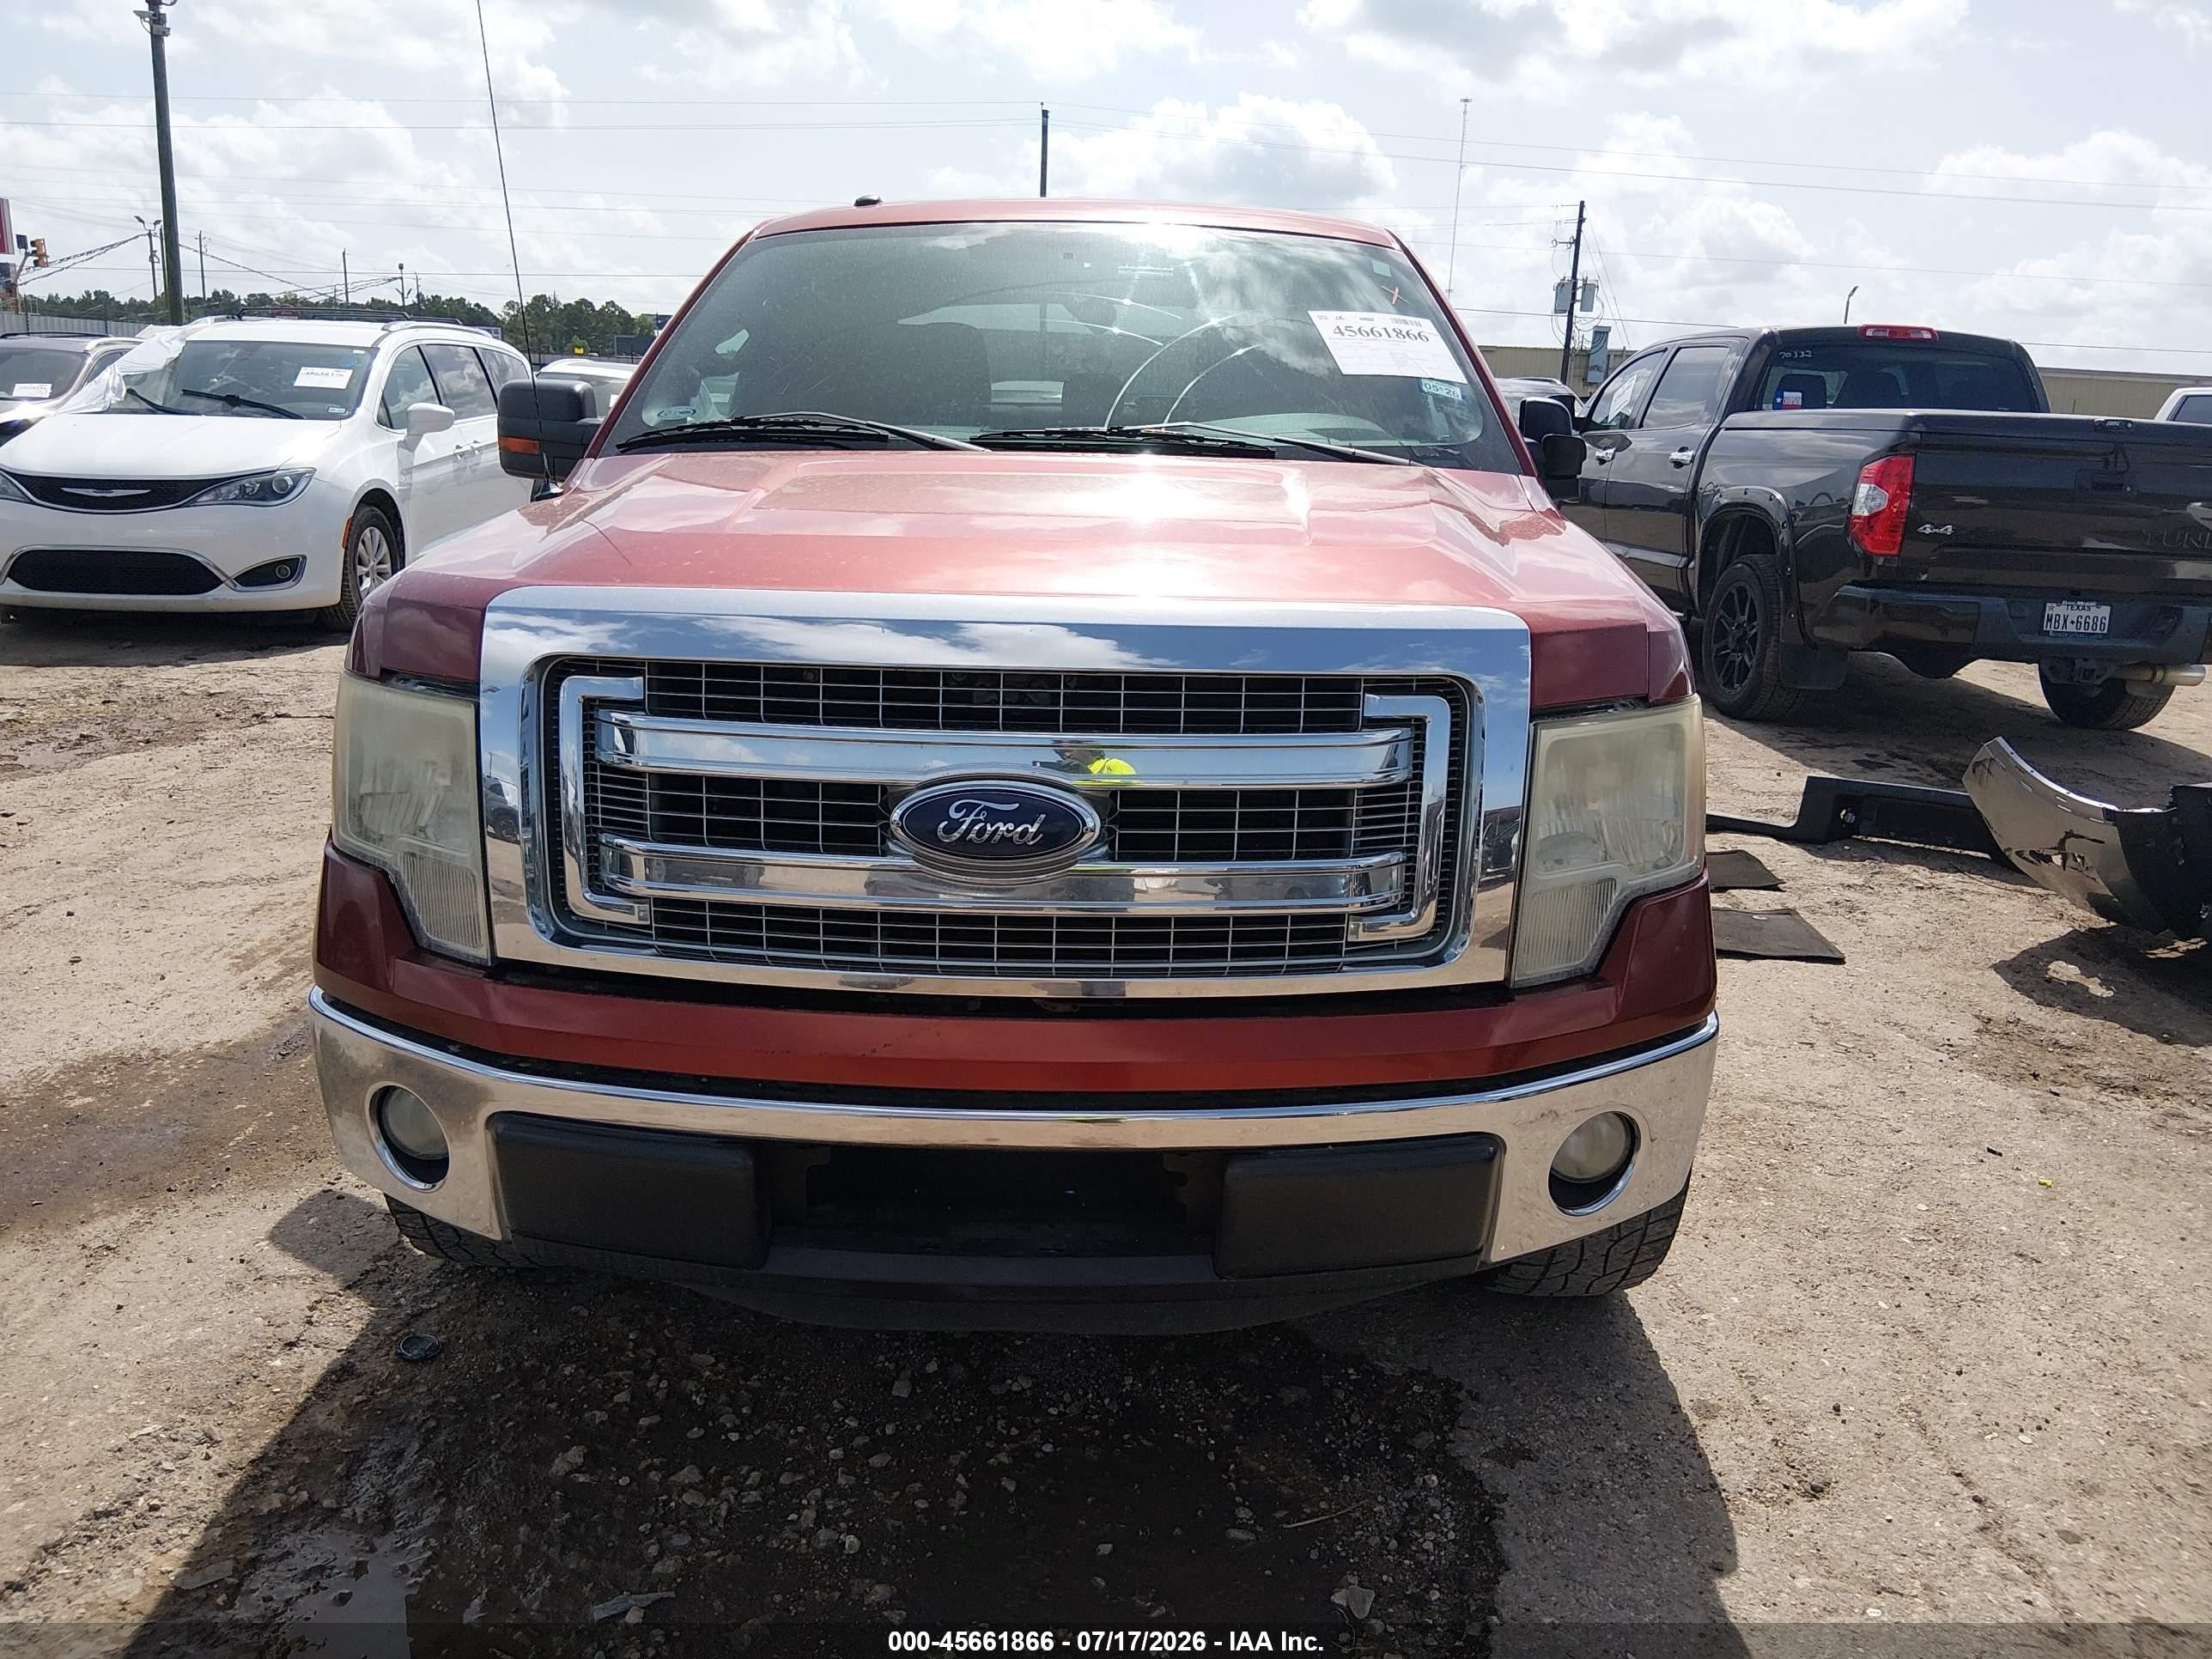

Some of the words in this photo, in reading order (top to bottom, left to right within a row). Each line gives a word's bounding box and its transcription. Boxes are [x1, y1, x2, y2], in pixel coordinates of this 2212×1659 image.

[1333, 325, 1430, 343] 45661866
[2066, 604, 2092, 612] TEXAS
[937, 799, 1046, 845] Ford
